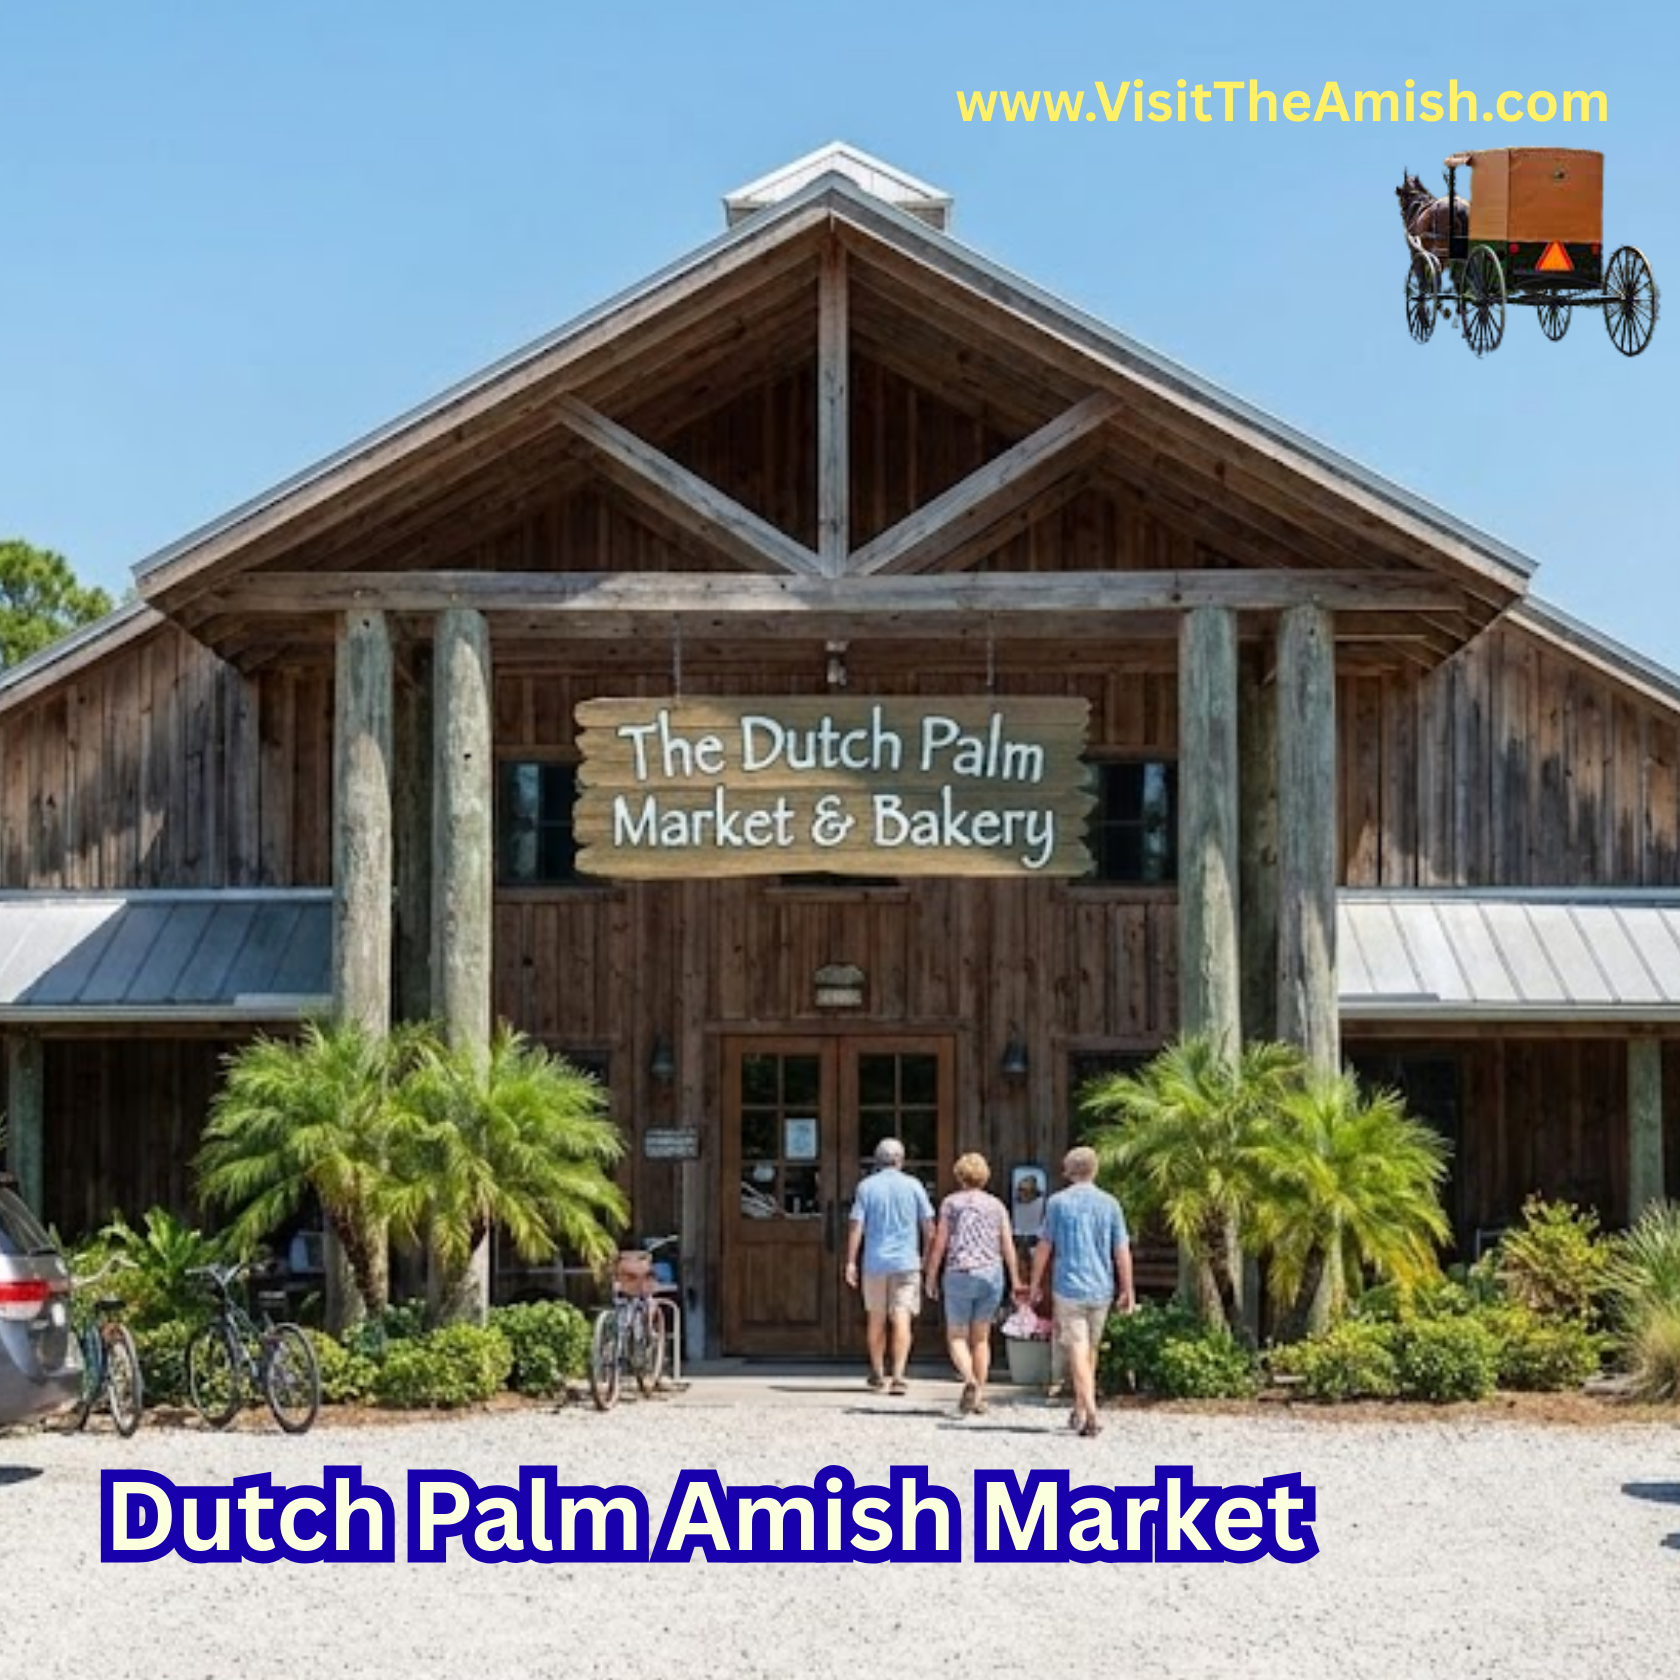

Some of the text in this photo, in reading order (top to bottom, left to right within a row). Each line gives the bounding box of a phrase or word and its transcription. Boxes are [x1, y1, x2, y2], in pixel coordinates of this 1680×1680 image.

[617, 706, 1044, 783] The Dutch Palm
[613, 785, 1055, 869] Market & Bakery
